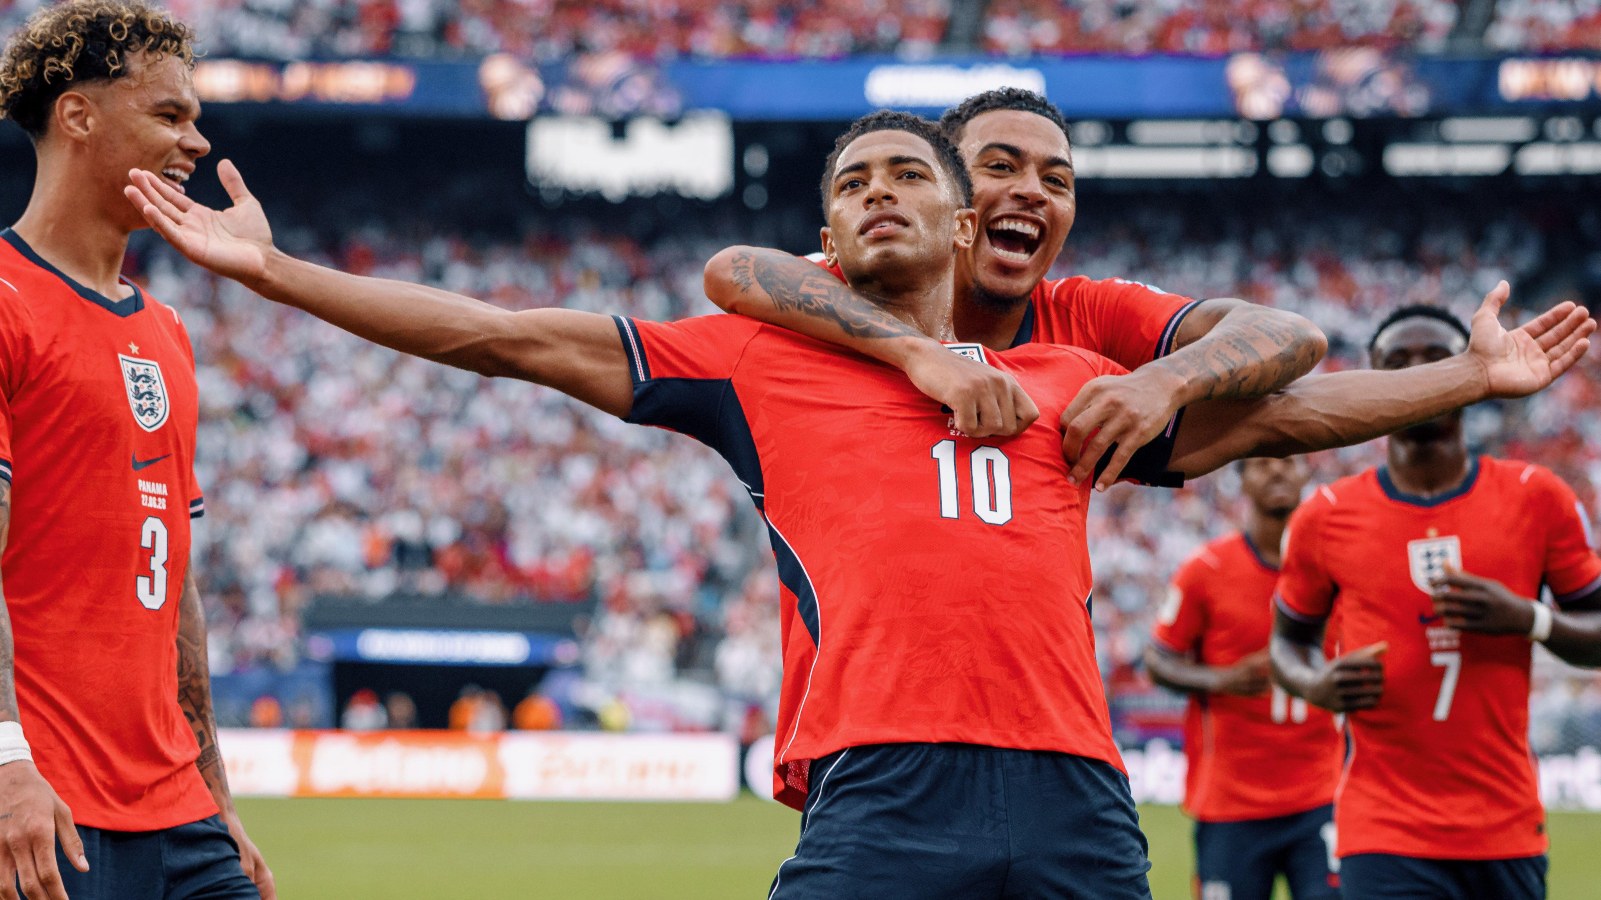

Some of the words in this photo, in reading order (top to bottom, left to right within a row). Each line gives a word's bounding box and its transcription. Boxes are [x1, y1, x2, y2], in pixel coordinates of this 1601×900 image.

[137, 479, 168, 496] PANAMA
[931, 439, 1013, 526] 10
[136, 515, 168, 611] 3
[1430, 651, 1462, 722] 7
